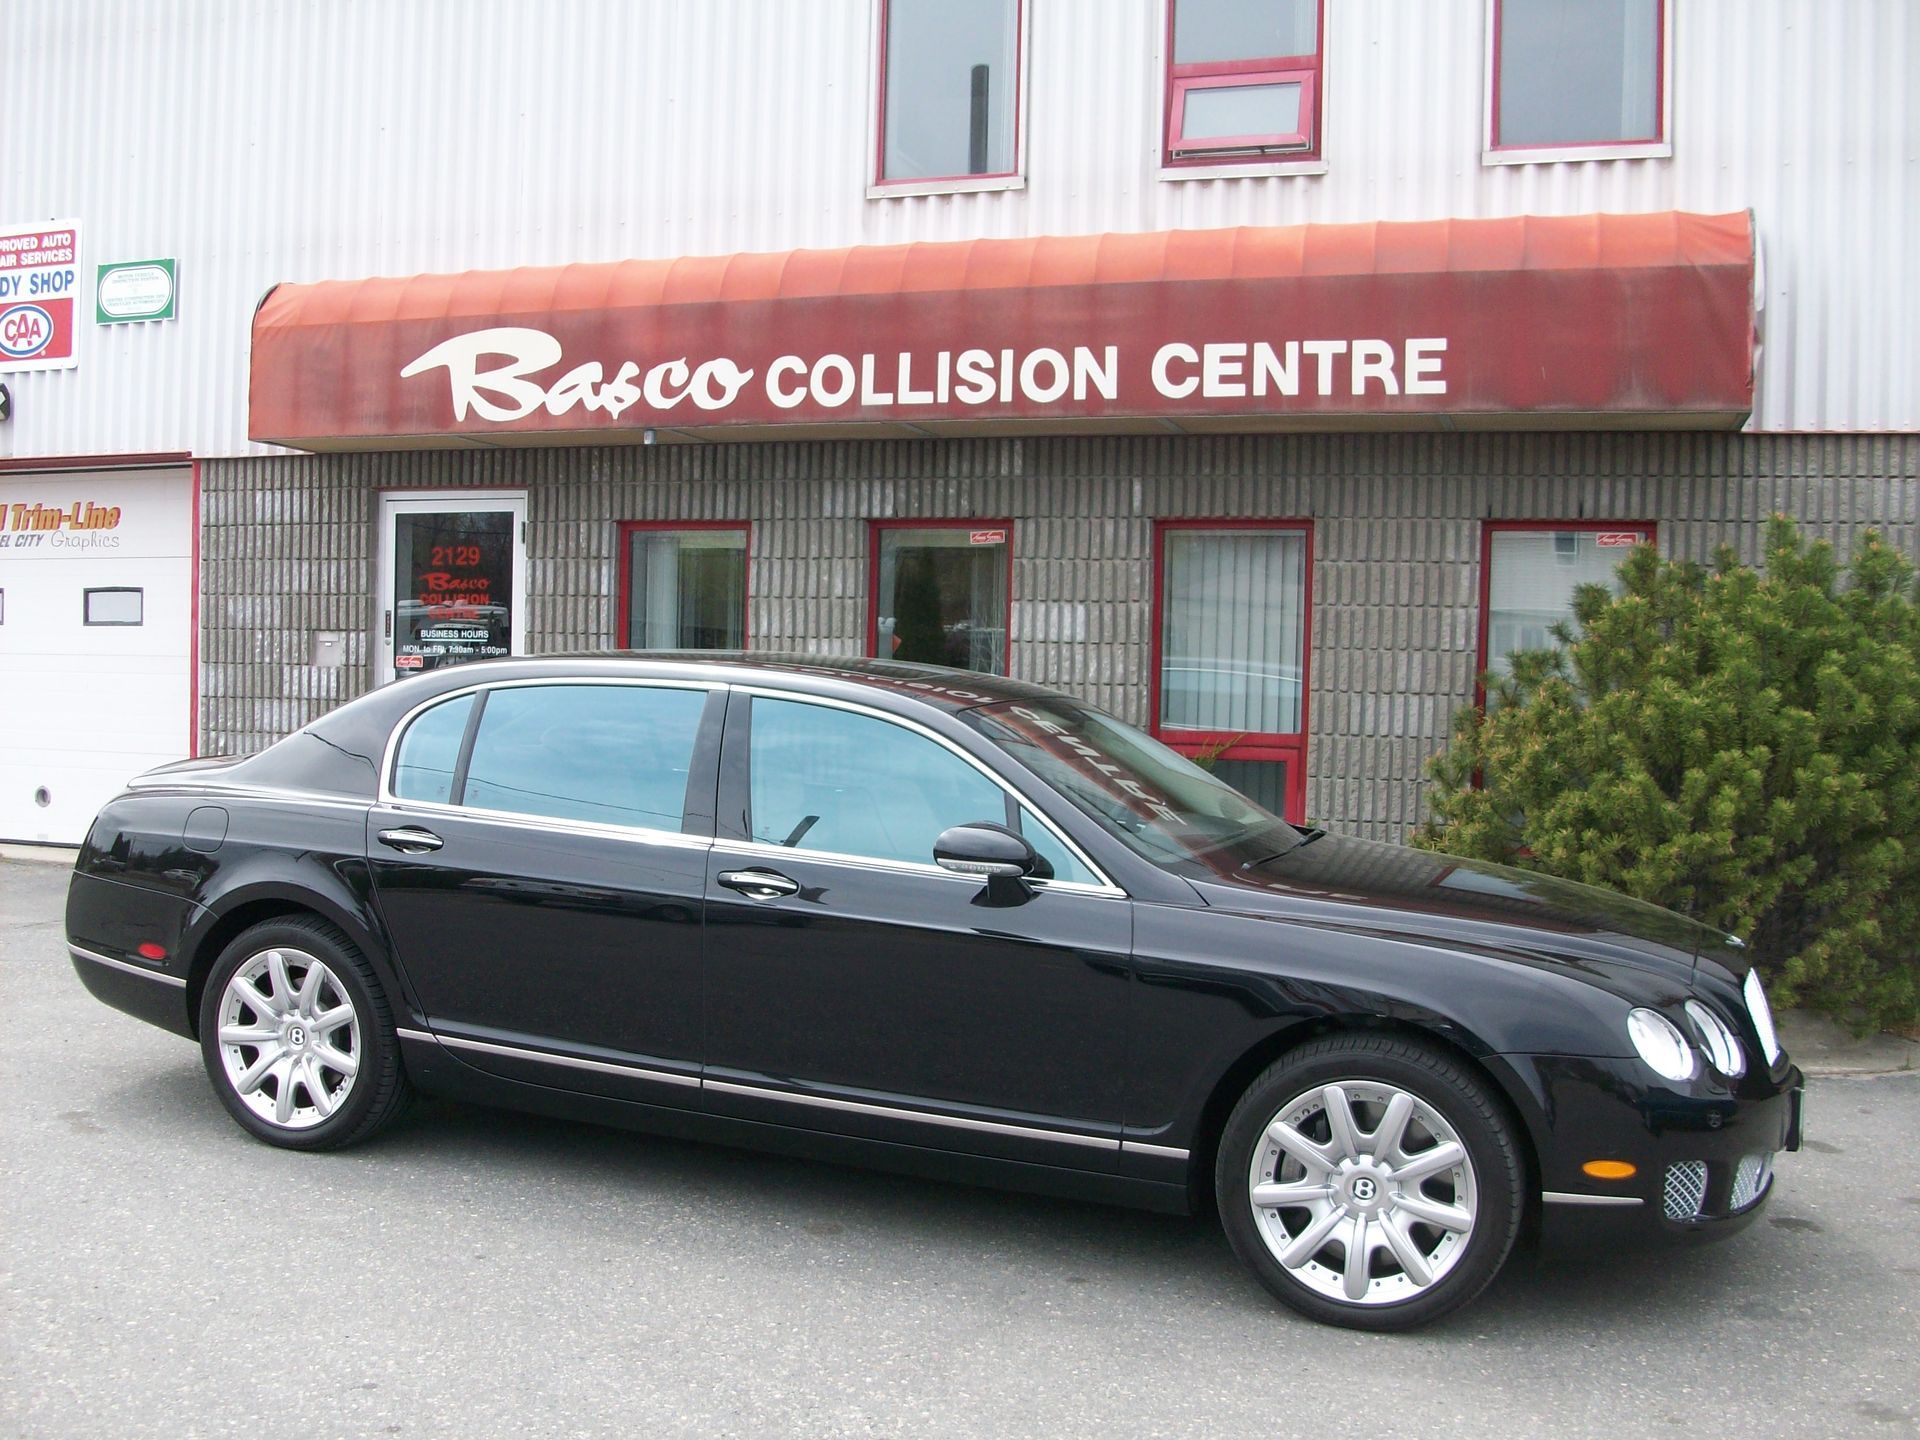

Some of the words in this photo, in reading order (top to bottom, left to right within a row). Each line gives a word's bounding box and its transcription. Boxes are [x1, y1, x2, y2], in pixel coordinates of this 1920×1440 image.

[42, 233, 71, 248] AUTO
[20, 249, 73, 266] SERVICES
[29, 270, 75, 295] SHOP
[4, 313, 42, 348] CAA
[400, 326, 754, 422] Basco
[765, 345, 1118, 408] COLLISION
[1151, 338, 1448, 399] CENTRE
[11, 502, 121, 531] Trim-Line
[0, 534, 11, 548] EL
[15, 534, 45, 548] CITY
[51, 531, 120, 552] Graphics
[431, 546, 480, 567] 2129
[418, 571, 491, 591] Basco
[419, 593, 489, 605] COLLISION
[420, 629, 459, 638] BUSINESS
[461, 630, 489, 639] HOURS
[423, 645, 430, 653] to
[481, 645, 508, 655] 5:00pm
